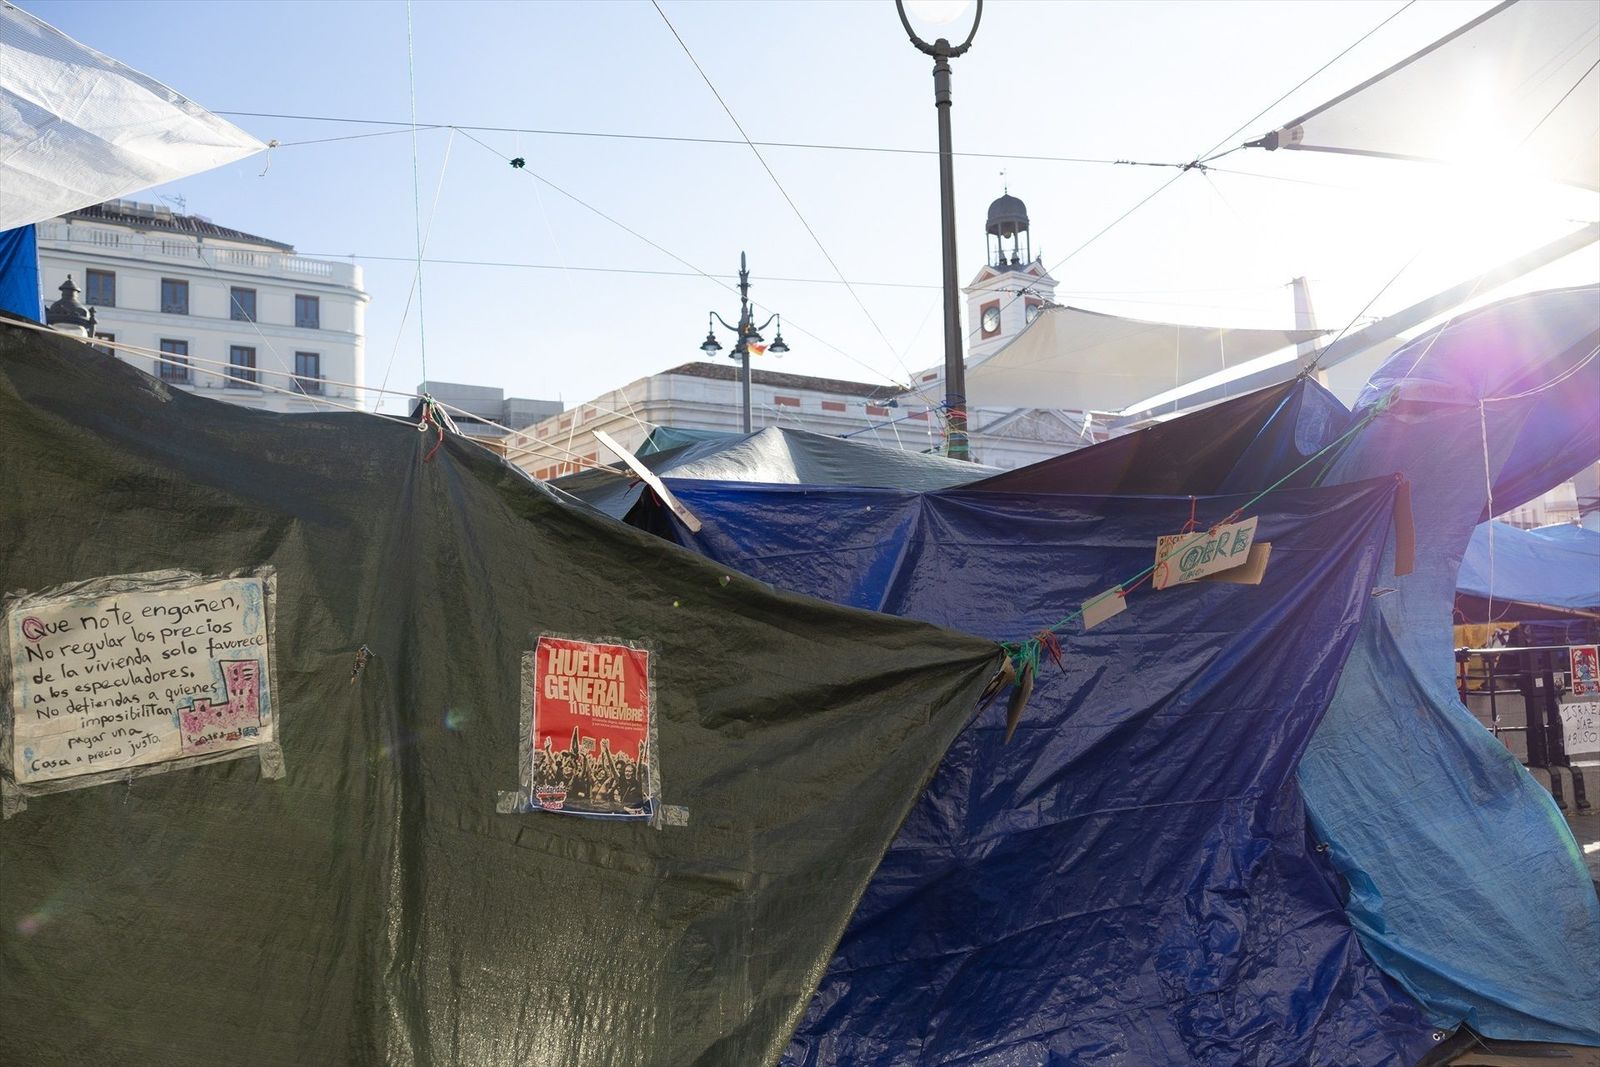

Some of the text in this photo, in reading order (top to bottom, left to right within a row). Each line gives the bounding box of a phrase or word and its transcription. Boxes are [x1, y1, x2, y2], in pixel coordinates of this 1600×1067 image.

[22, 616, 73, 642] Que
[142, 597, 240, 624] engañen,
[25, 618, 233, 663] No regular los precios
[33, 637, 266, 685] de la vivienda solo favorece
[548, 648, 625, 681] HUELGA
[33, 666, 196, 704] a los especuladores.
[36, 682, 218, 720] No defiendas a quienes
[544, 674, 629, 708] GENERAL
[81, 703, 173, 729] imposibilitan
[569, 700, 578, 715] 11
[578, 702, 591, 717] DE
[591, 704, 644, 722] NOVIEMBRE
[1563, 704, 1600, 722] ISRAE
[67, 727, 143, 750] pagar una
[31, 759, 72, 772] Casa
[76, 755, 82, 763] a
[88, 746, 122, 764] precio
